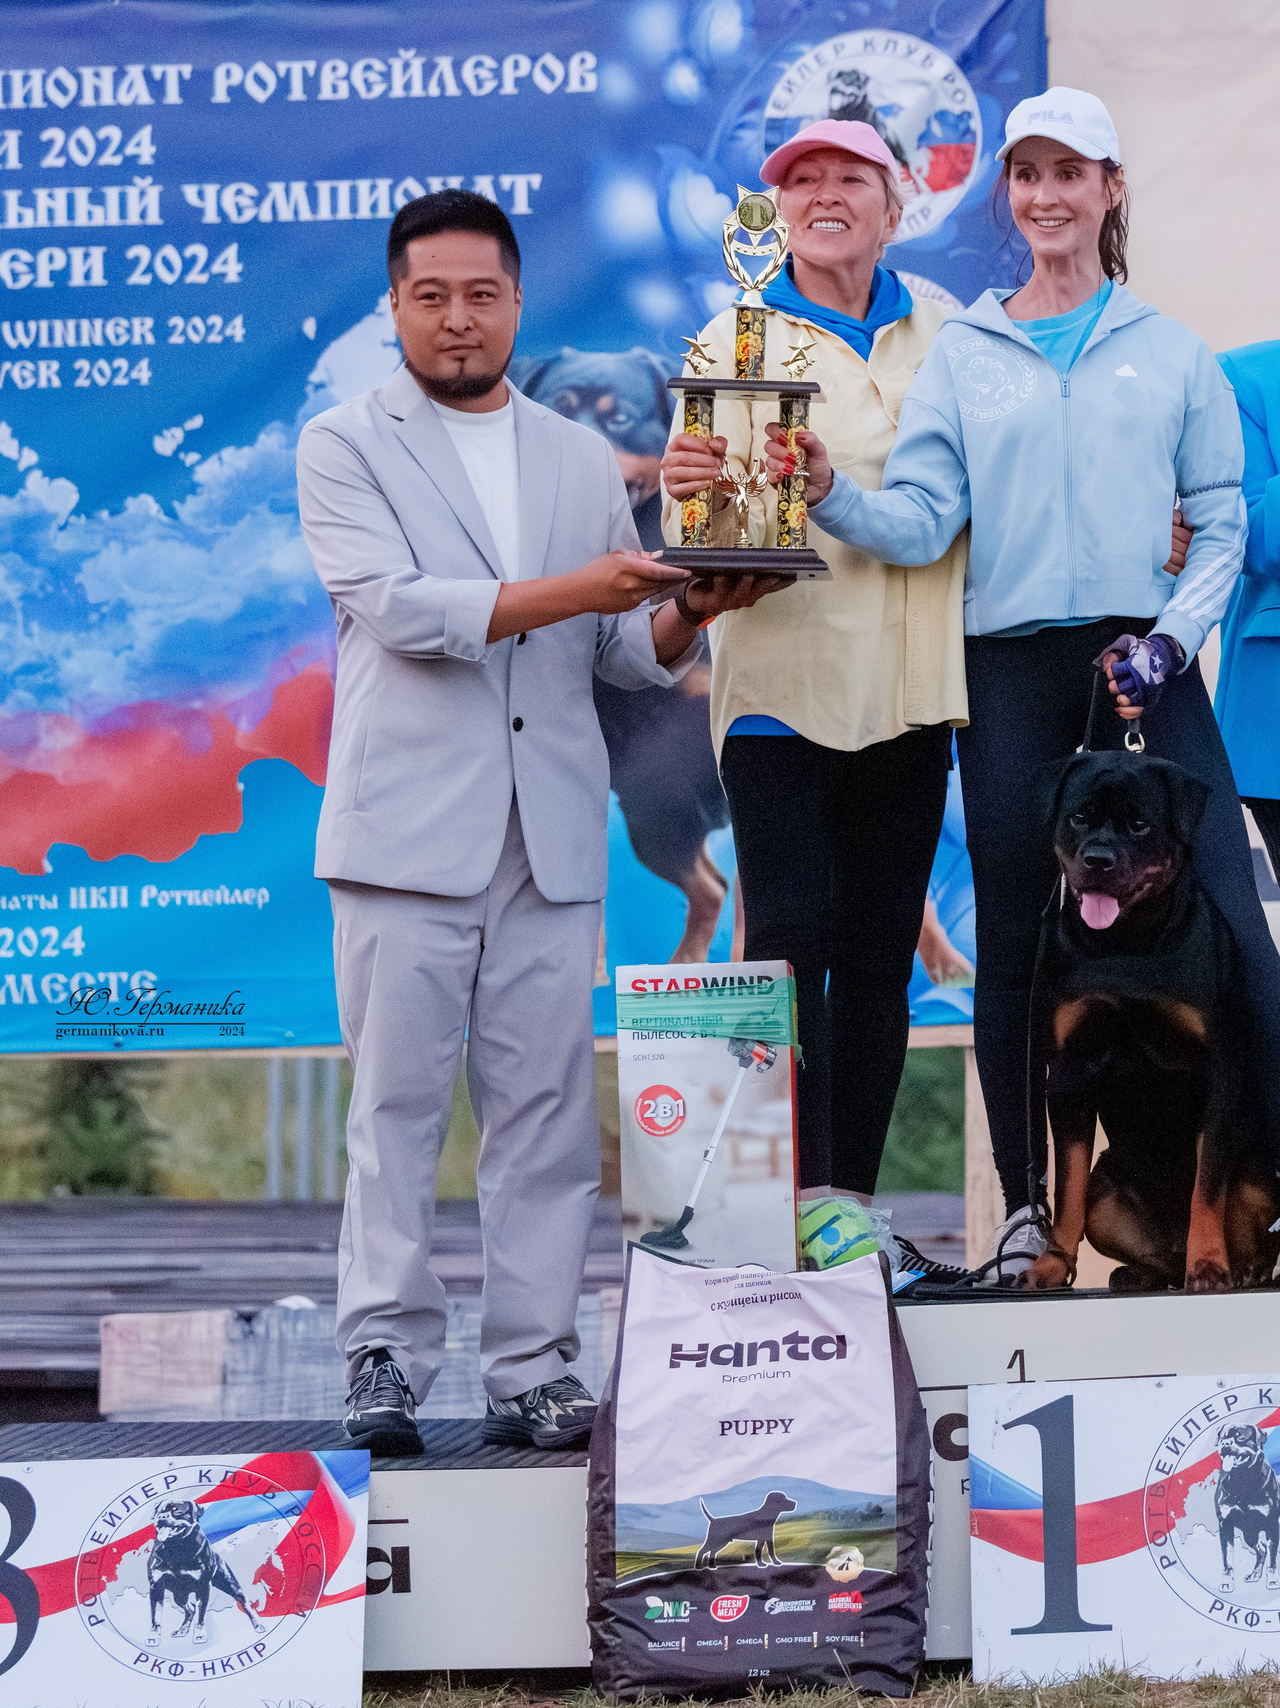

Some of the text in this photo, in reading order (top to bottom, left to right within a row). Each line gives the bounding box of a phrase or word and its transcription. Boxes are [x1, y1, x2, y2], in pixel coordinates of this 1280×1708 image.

[863, 38, 936, 69] КЛУБ
[0, 48, 599, 109] ИОНАТ РОТВЕЙЛЕРОВ
[1027, 109, 1074, 126] FILA
[40, 124, 156, 168] 2024
[125, 243, 243, 286] 2024
[1, 315, 245, 349] WINNER 2024
[960, 340, 992, 352] DOMA
[73, 357, 152, 387] 2024
[140, 884, 270, 911] Ротвейлер
[0, 925, 86, 958] 2024
[0, 970, 158, 1004] МЕСТЕ
[631, 975, 775, 999] STARWIND
[632, 1030, 688, 1041] ПЫЛЕСОС
[632, 1054, 665, 1062] SCH1320
[705, 1278, 723, 1287] Корм
[760, 1294, 768, 1302] и
[769, 1291, 802, 1304] рисом
[669, 1331, 848, 1369] Hanta
[722, 1369, 791, 1385] Premium
[718, 1418, 795, 1437] PUPPY
[1148, 1394, 1240, 1570] РОТВЕЙЛЕР
[1001, 1394, 1113, 1635] 1
[79, 1474, 178, 1628] РОТВЕЙЛЕР
[199, 1468, 277, 1501] КЛУБ
[285, 1504, 323, 1619] РОССИИ
[663, 1601, 691, 1618] NWC
[717, 1608, 738, 1617] MEAT
[718, 1600, 742, 1608] FRESH
[133, 1642, 268, 1678] РКФ-НКПР
[748, 1669, 759, 1677] 12
